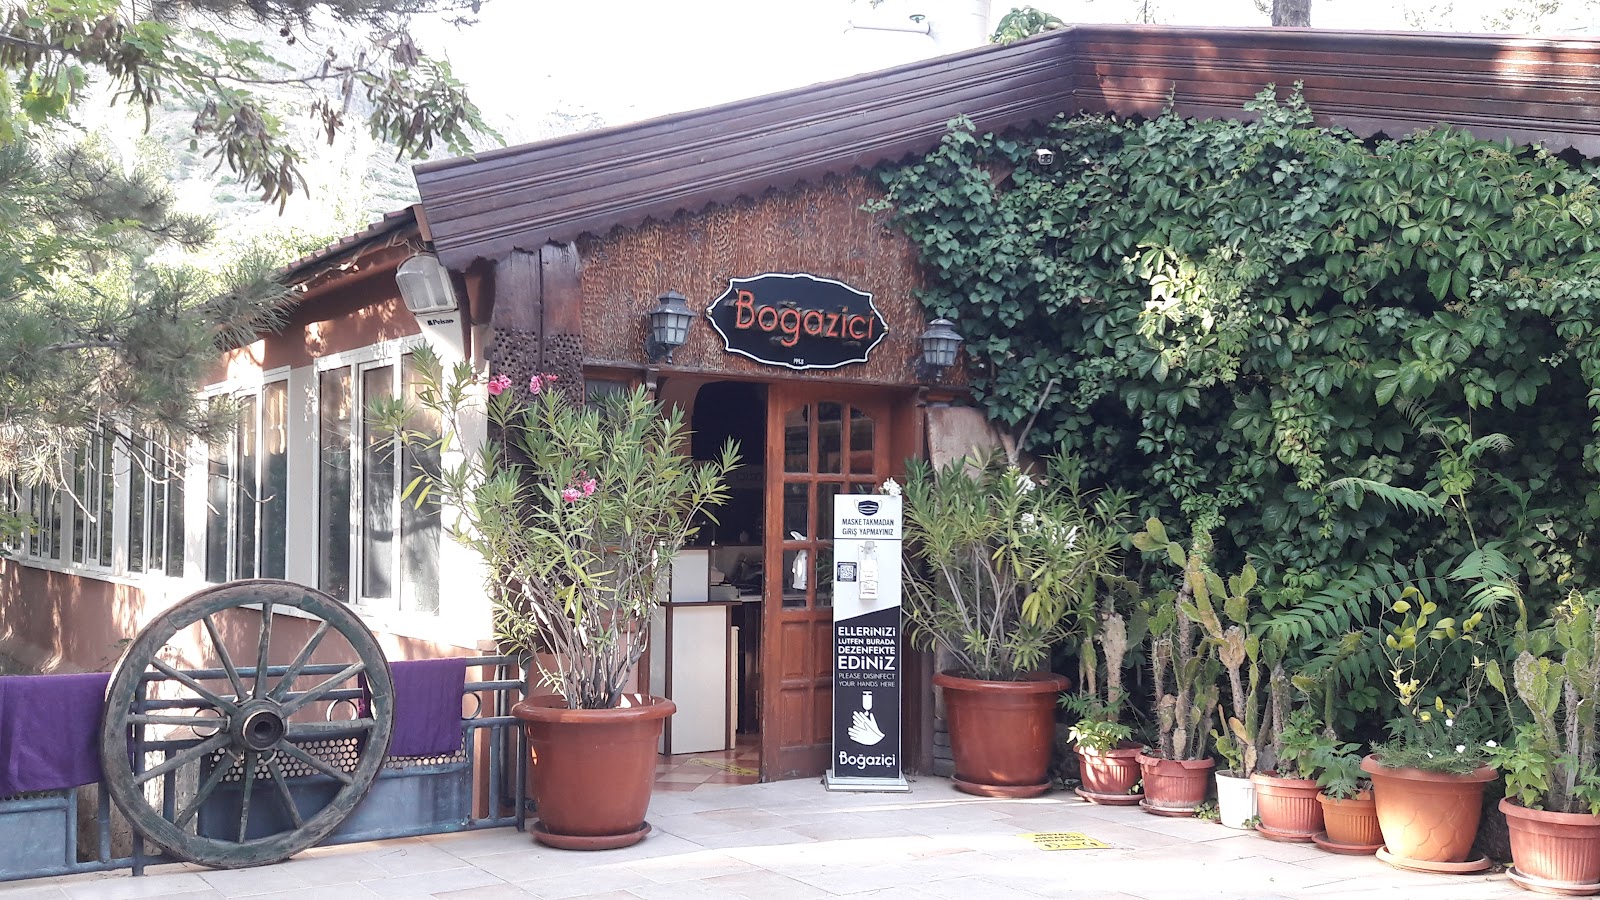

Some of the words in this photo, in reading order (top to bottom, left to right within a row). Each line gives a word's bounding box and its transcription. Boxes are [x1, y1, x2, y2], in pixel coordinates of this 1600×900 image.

[842, 518, 862, 526] MASKE
[863, 518, 895, 526] TAKMADAN
[859, 528, 894, 536] YAPMAYINIZ
[838, 645, 896, 655] DEZENFEKTE
[839, 751, 896, 770] Boğaziçi
